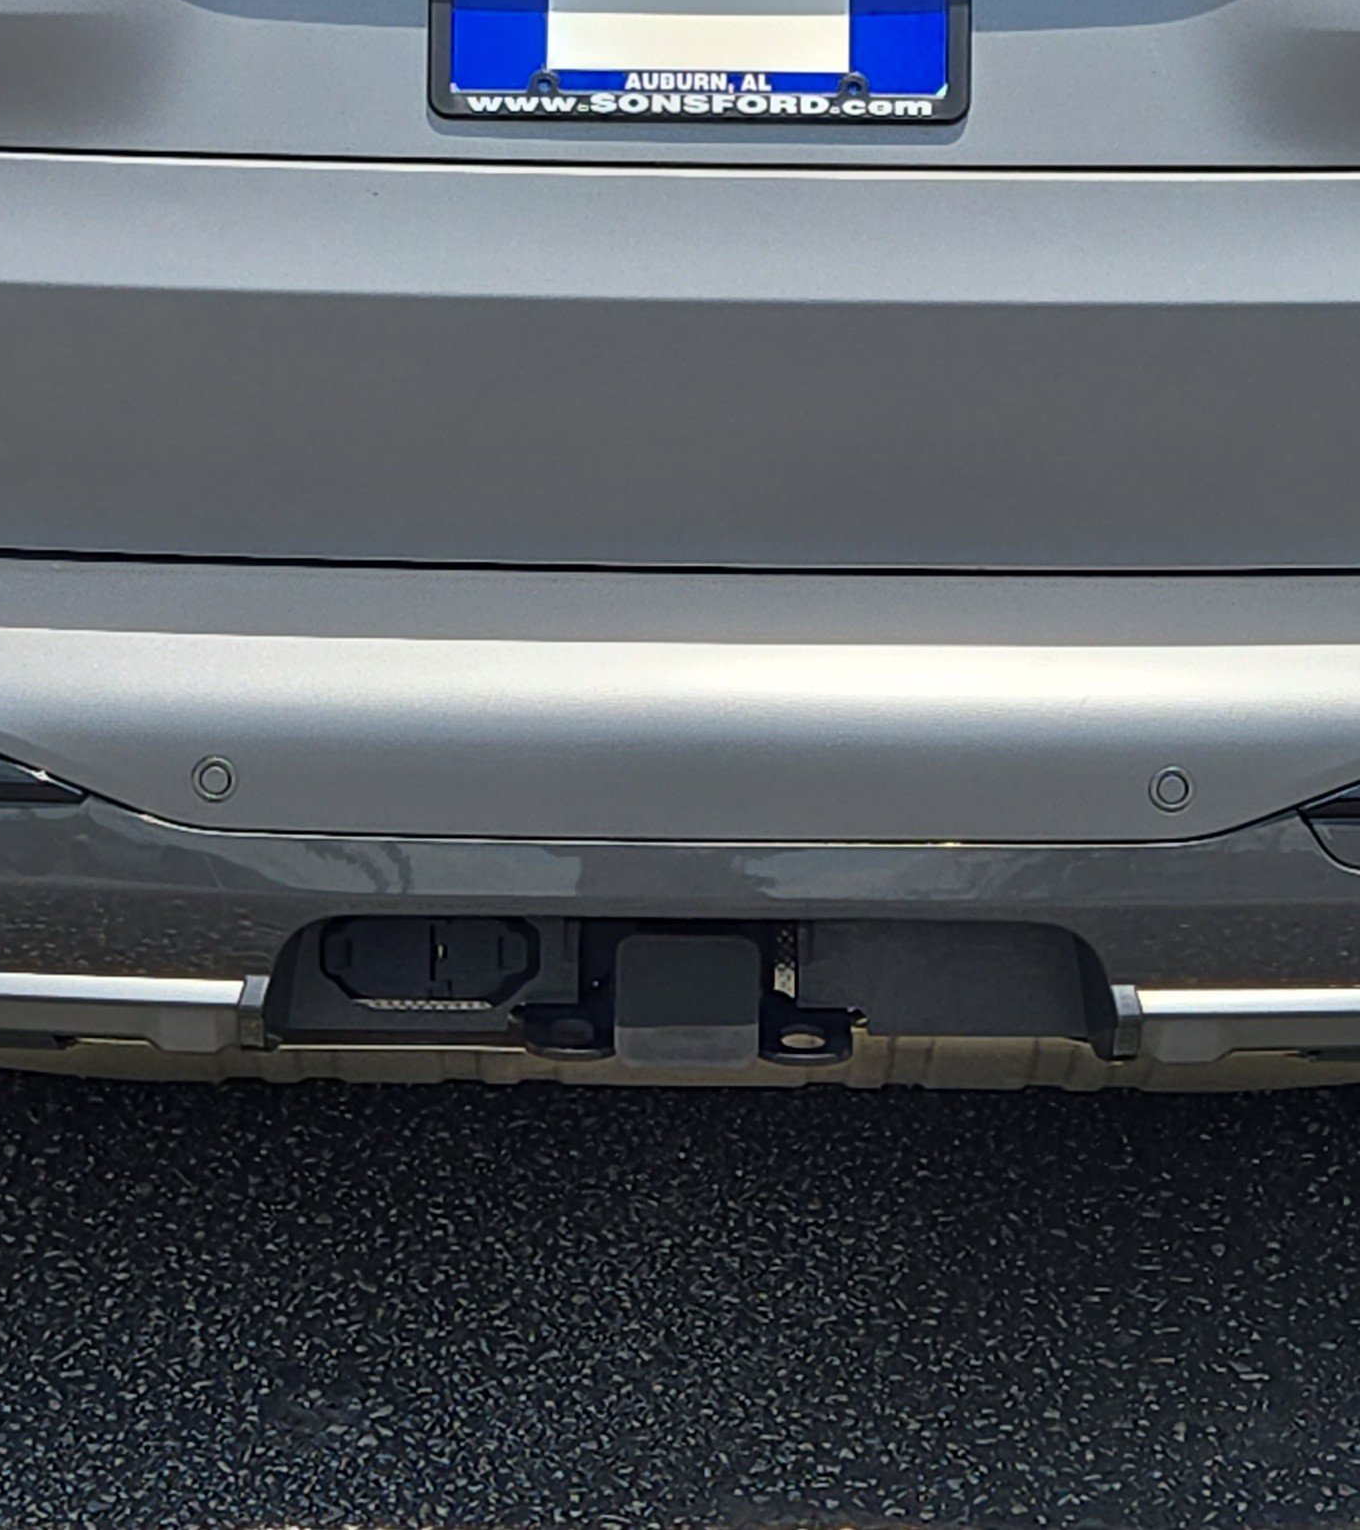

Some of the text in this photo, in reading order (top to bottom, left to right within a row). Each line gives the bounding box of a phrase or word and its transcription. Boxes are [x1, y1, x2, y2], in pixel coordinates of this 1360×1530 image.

[624, 71, 772, 95] AUBURN, AL
[466, 92, 934, 118] www.SONSFORD.com
